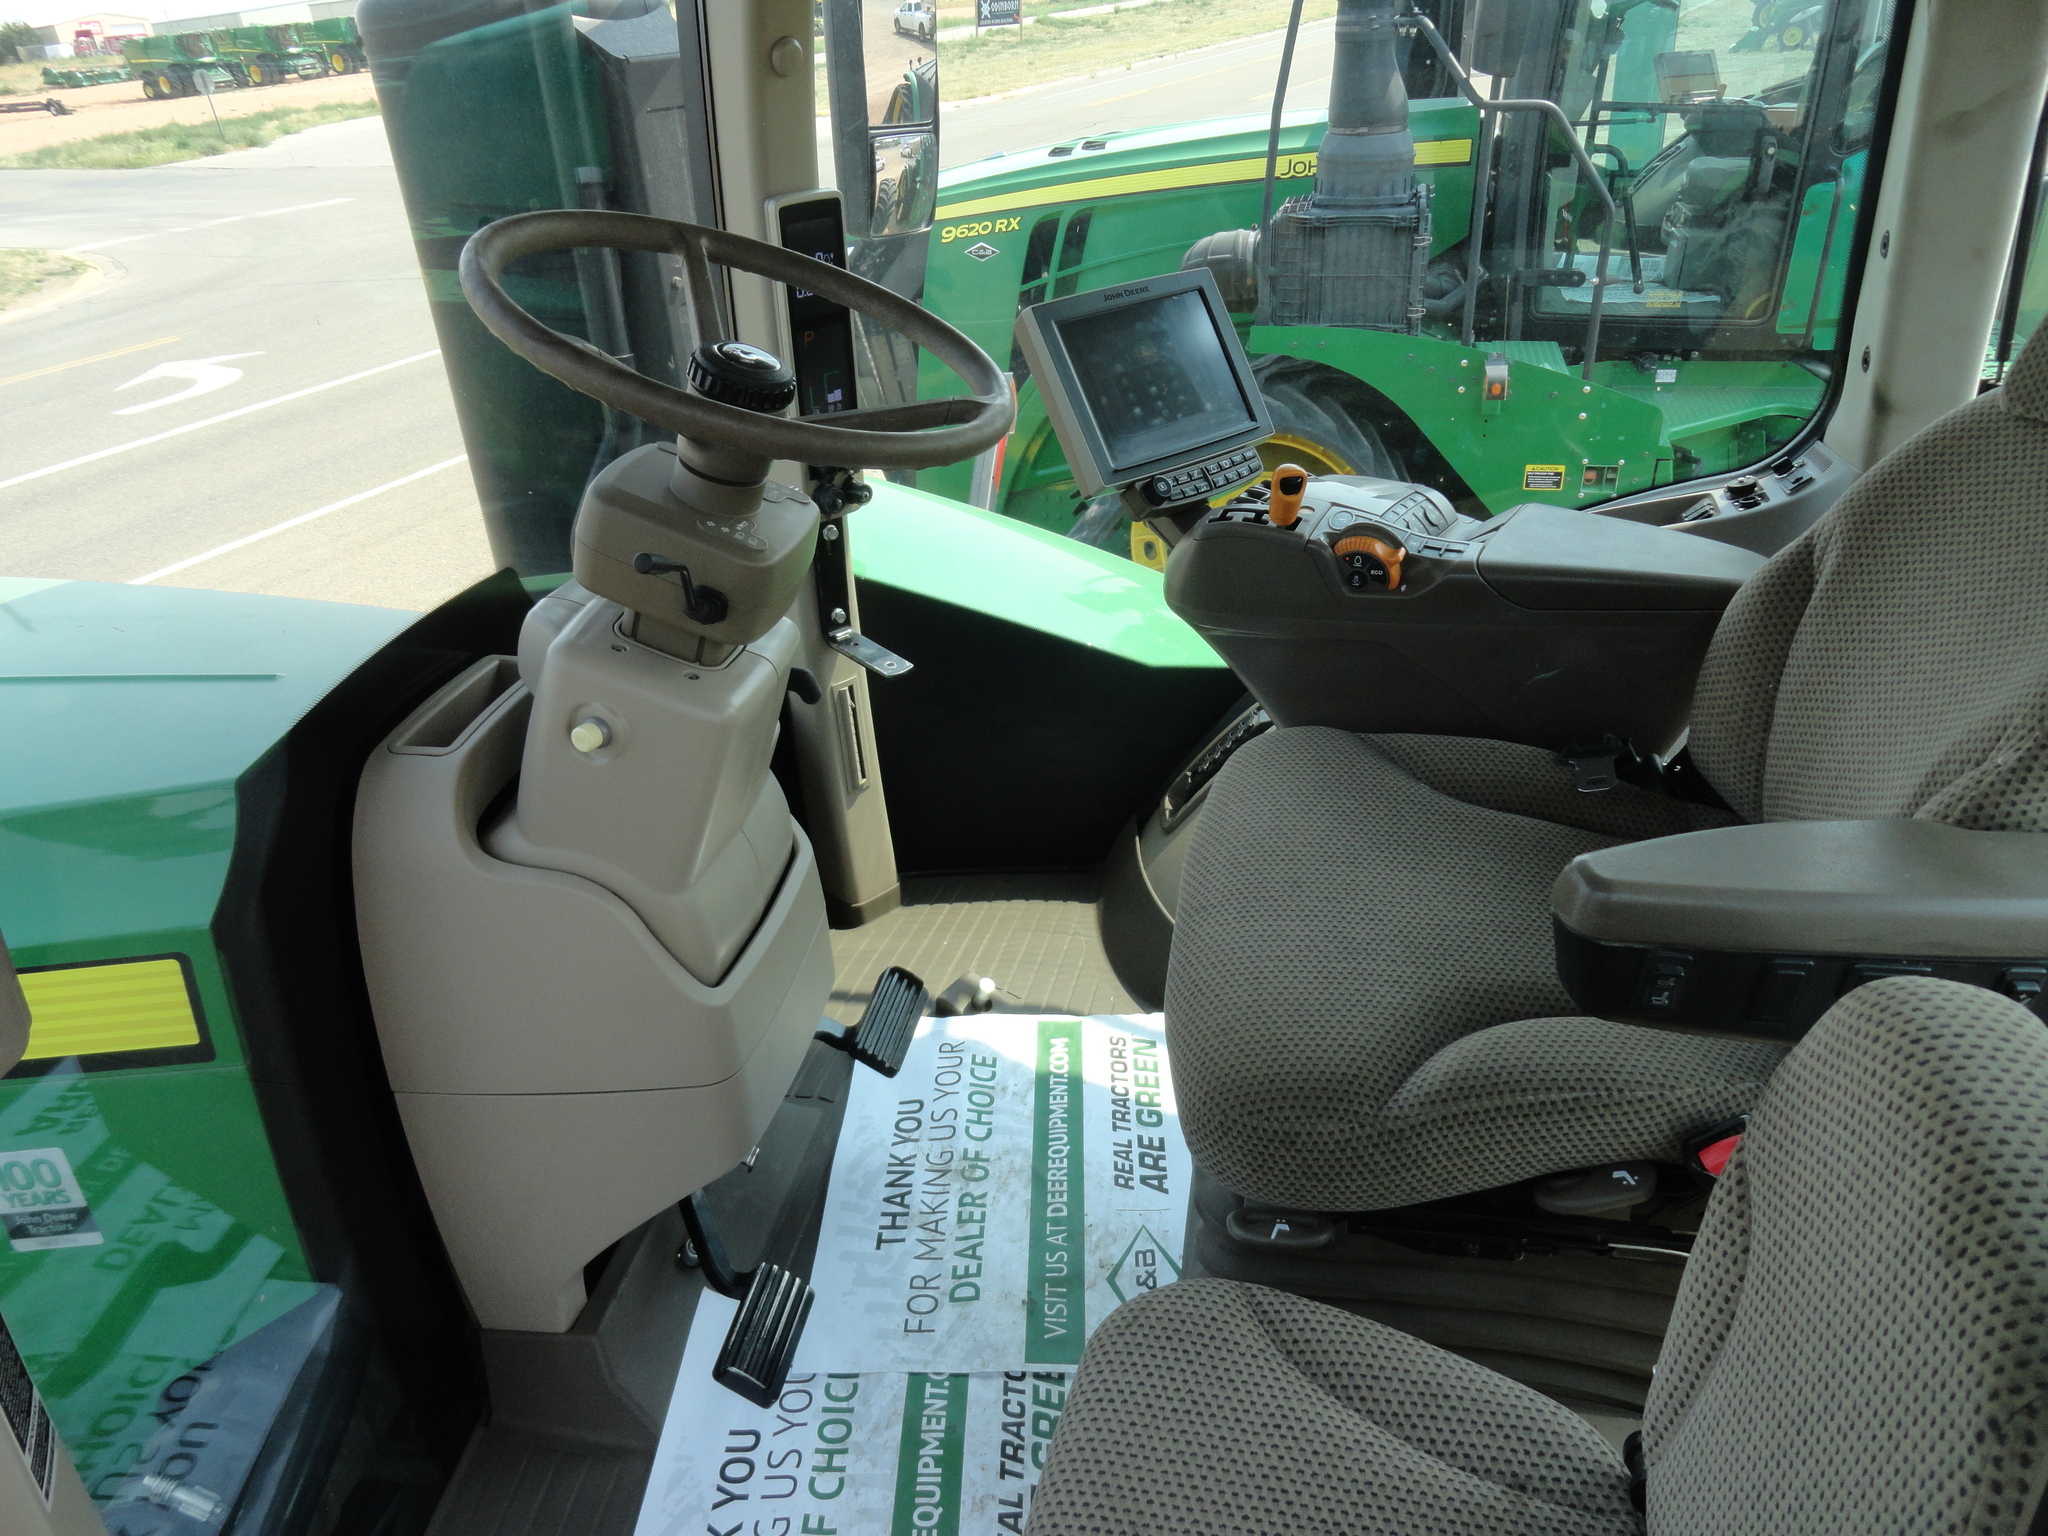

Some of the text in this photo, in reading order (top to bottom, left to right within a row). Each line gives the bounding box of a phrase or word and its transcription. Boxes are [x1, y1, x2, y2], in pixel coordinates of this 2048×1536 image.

[941, 216, 1021, 243] 9620 RX
[1103, 286, 1150, 302] JOHN DEERE
[804, 331, 814, 348] P
[1109, 1036, 1135, 1191] REAL TRACTORS
[1133, 1038, 1169, 1195] ARE GREEN
[0, 1157, 62, 1192] 100
[2, 1188, 72, 1208] YEARS
[875, 1099, 924, 1250] THANK YOU
[903, 1041, 965, 1333] FOR MAKING US YOUR
[949, 1053, 998, 1303] DEALER OF CHOICE
[1044, 1037, 1069, 1338] VISIT US AT DEEREQUIPMENT.COM
[15, 1213, 78, 1225] John Deere
[1134, 1248, 1158, 1294] &B
[711, 1429, 761, 1511] YOU
[760, 1449, 803, 1499] US
[912, 1372, 950, 1536] EQUIPMENT.
